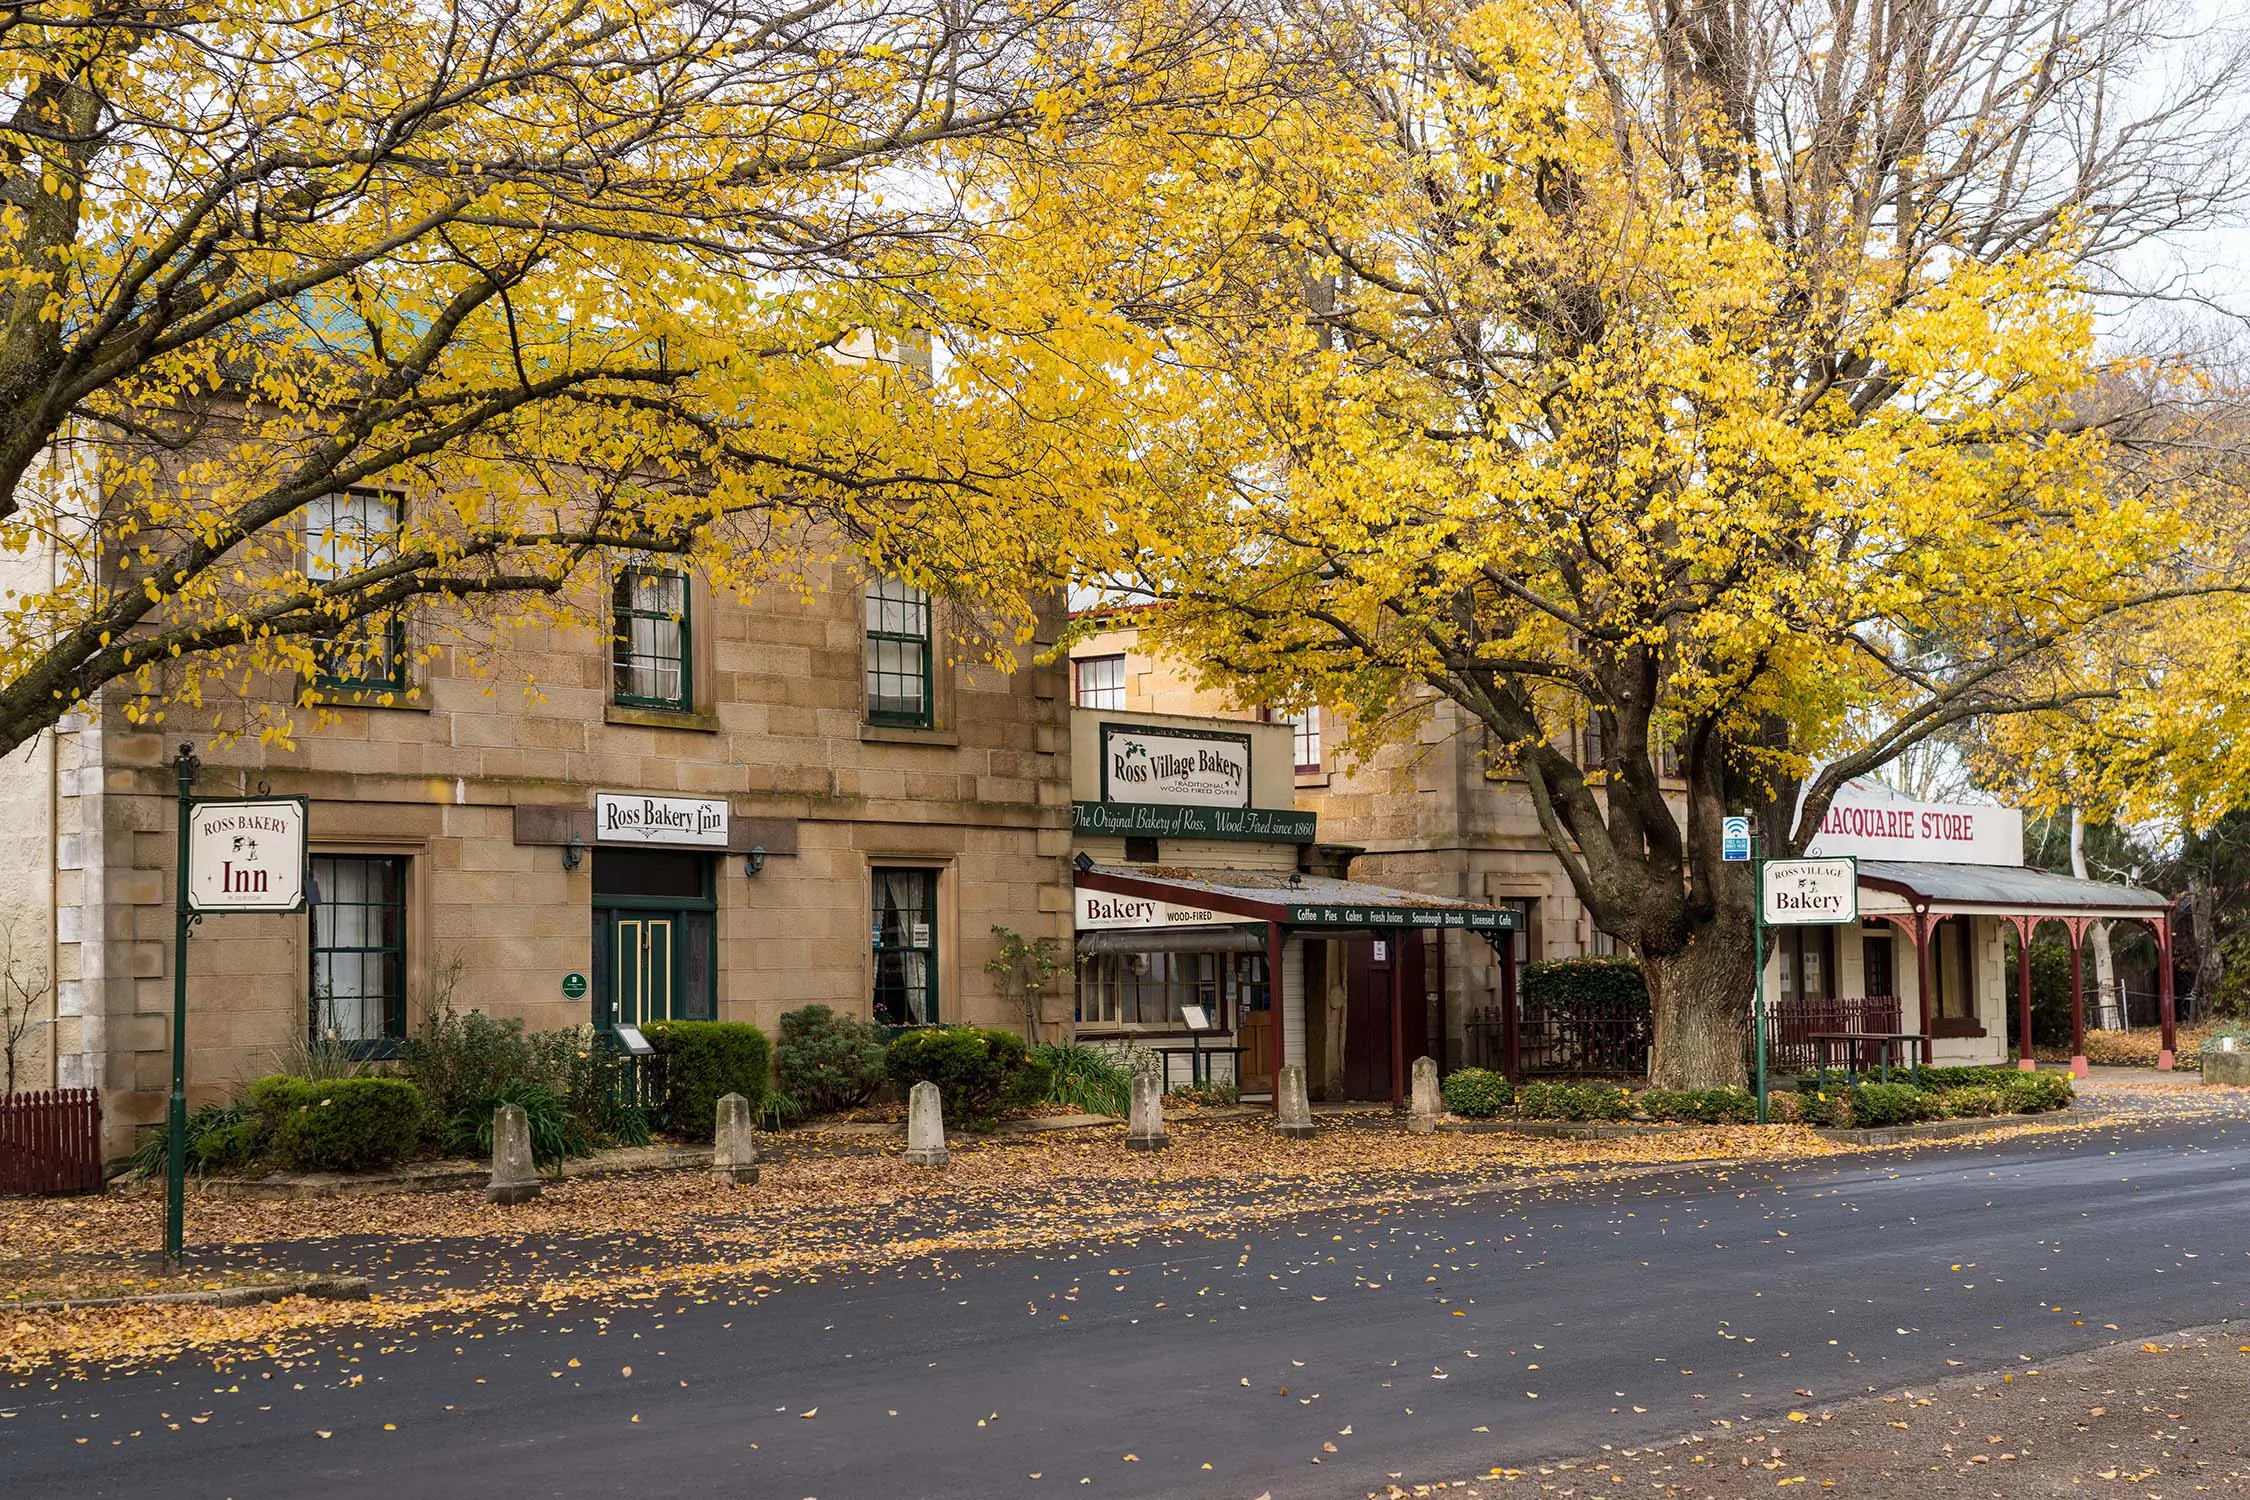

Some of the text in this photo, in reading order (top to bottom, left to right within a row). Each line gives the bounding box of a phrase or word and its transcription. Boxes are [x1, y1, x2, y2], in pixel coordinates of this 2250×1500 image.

[1114, 749, 1243, 787] Ross Village Bakery
[1174, 780, 1225, 789] TRADITIONAL
[204, 815, 288, 836] ROSS BAKERY
[606, 799, 721, 835] Ross Bakery Inn
[1072, 804, 1315, 836] The Original Bakery of Ross, Wood-Fired since 1860
[1921, 812, 1973, 841] STORE
[221, 861, 268, 893] Inn
[1774, 866, 1844, 880] ROSS VILLAGE
[1087, 898, 1156, 923] Bakery
[1776, 892, 1843, 913] Bakery
[1167, 911, 1213, 922] WOOD-FIRED
[1297, 908, 1512, 926] Coffee Pies Cakes Fresh Juices Sourdough Breads Licensed Cafe
